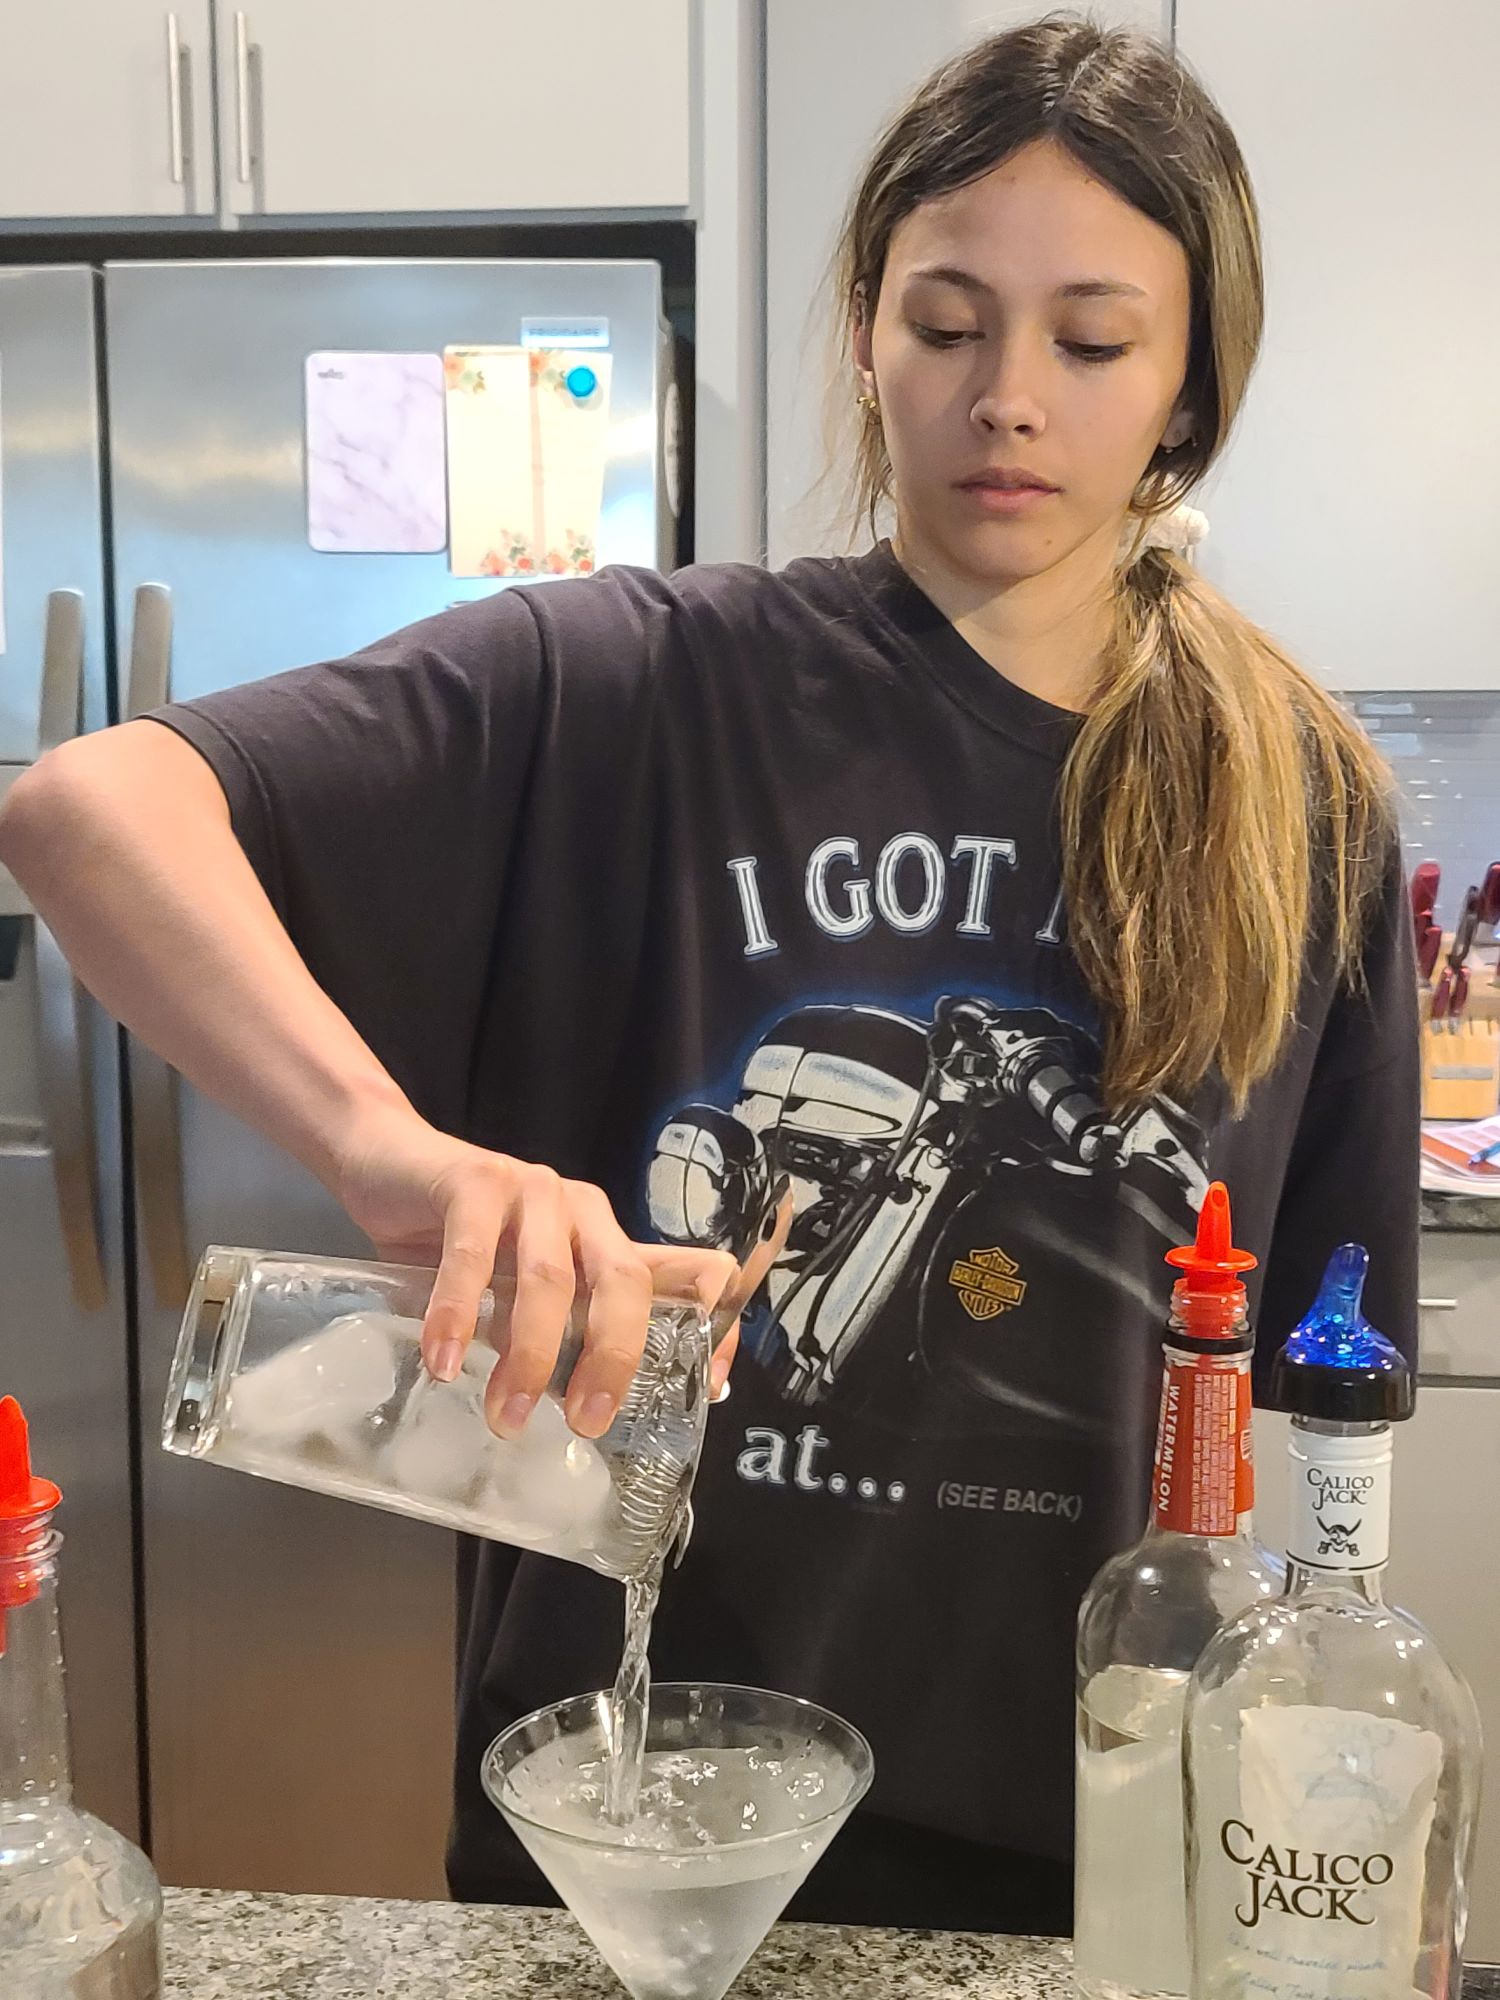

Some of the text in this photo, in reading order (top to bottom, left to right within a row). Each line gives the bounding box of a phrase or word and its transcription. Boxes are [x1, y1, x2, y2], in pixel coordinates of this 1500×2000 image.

[726, 856, 779, 956] I
[804, 831, 1018, 938] GOT
[1158, 1385, 1181, 1512] WATERMELON
[937, 1480, 1084, 1523] (SEE BACK)
[1306, 1467, 1375, 1490] CALICO
[1311, 1487, 1367, 1511] JACK
[1220, 1818, 1395, 1886] CALICO
[1234, 1870, 1377, 1928] JACK
